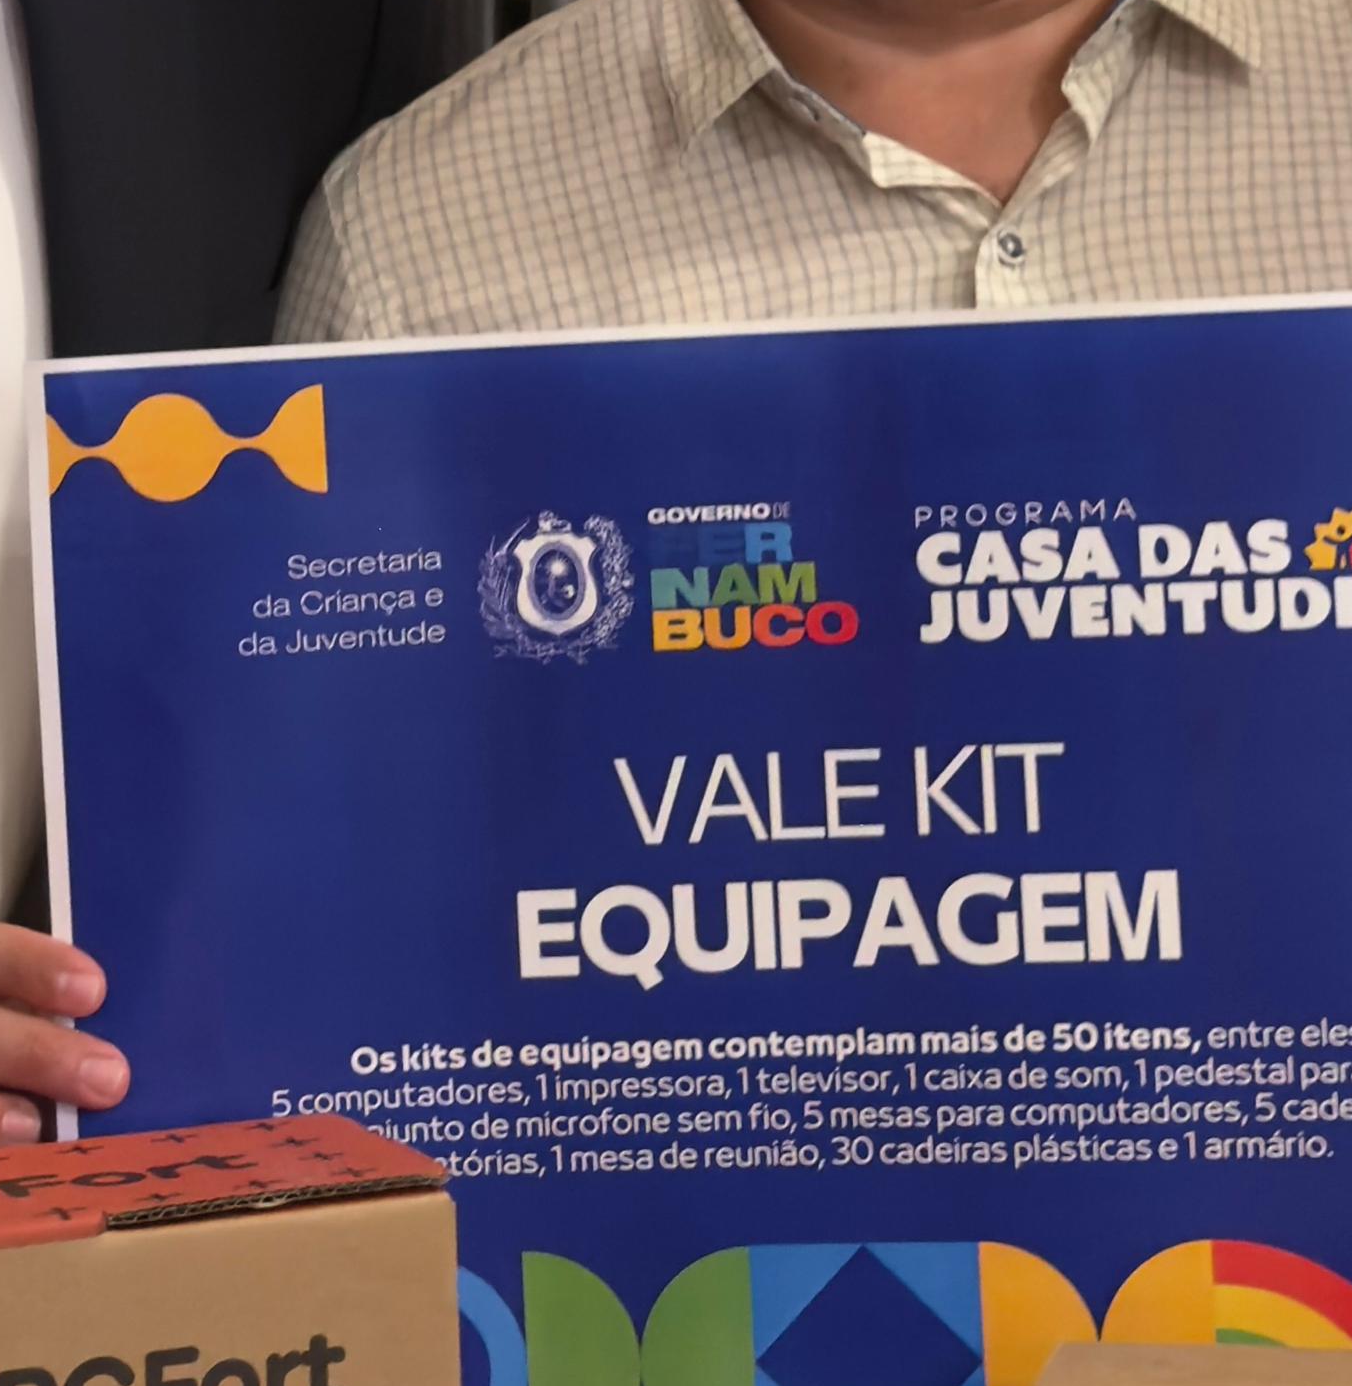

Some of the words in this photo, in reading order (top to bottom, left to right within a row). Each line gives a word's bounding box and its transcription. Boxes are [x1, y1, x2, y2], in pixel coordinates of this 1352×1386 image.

[647, 502, 771, 525] GOVERNO
[914, 497, 1137, 529] PROGRAMA
[287, 547, 442, 580] Secretaria
[916, 526, 1121, 586] CASA
[1138, 518, 1292, 578] DAS
[252, 594, 291, 619] da
[299, 589, 416, 616] Criança
[424, 587, 444, 607] e
[651, 561, 817, 608] NAM
[238, 631, 278, 657] da
[285, 620, 446, 654] Juventude
[653, 601, 859, 652] BUCO
[613, 748, 885, 845] VALE
[914, 742, 1065, 836] KIT
[516, 869, 1183, 991] EQUIPAGEM
[350, 1046, 397, 1075] Os
[401, 1043, 467, 1072] kits
[471, 1039, 514, 1068] de
[519, 1036, 703, 1072] equipagem
[708, 1026, 916, 1063] contemplam
[920, 1024, 999, 1054] mais
[1003, 1023, 1046, 1053] de
[1053, 1021, 1099, 1052] 50
[1104, 1022, 1202, 1054] itens,
[1207, 1020, 1295, 1049] entre
[271, 1089, 291, 1117] 5
[298, 1075, 530, 1117] computadores,
[535, 1073, 548, 1101] 1
[555, 1074, 732, 1106] impressora,
[736, 1066, 749, 1095] 1
[755, 1064, 900, 1096] televisor,
[904, 1062, 917, 1091] 1
[923, 1063, 1003, 1091] caixa
[1007, 1060, 1048, 1090] de
[1054, 1065, 1130, 1092] som,
[1133, 1058, 1147, 1087] 1
[1154, 1055, 1295, 1094] pedestal
[470, 1111, 510, 1141] de
[515, 1106, 671, 1138] microfone
[677, 1110, 743, 1133] sem
[747, 1101, 798, 1134] fio,
[803, 1100, 824, 1130] 5
[830, 1105, 932, 1129] mesas
[936, 1104, 1005, 1134] para
[1010, 1094, 1249, 1132] computadores,
[1255, 1091, 1277, 1122] 5
[550, 1144, 563, 1173] 1
[570, 1148, 654, 1172] mesa
[659, 1140, 698, 1170] de
[704, 1139, 826, 1171] reunião,
[831, 1136, 874, 1166] 30
[879, 1134, 1008, 1165] cadeiras
[1013, 1133, 1153, 1170] plásticas
[1157, 1138, 1179, 1161] e
[1183, 1130, 1197, 1160] 1
[1203, 1129, 1334, 1160] armário.
